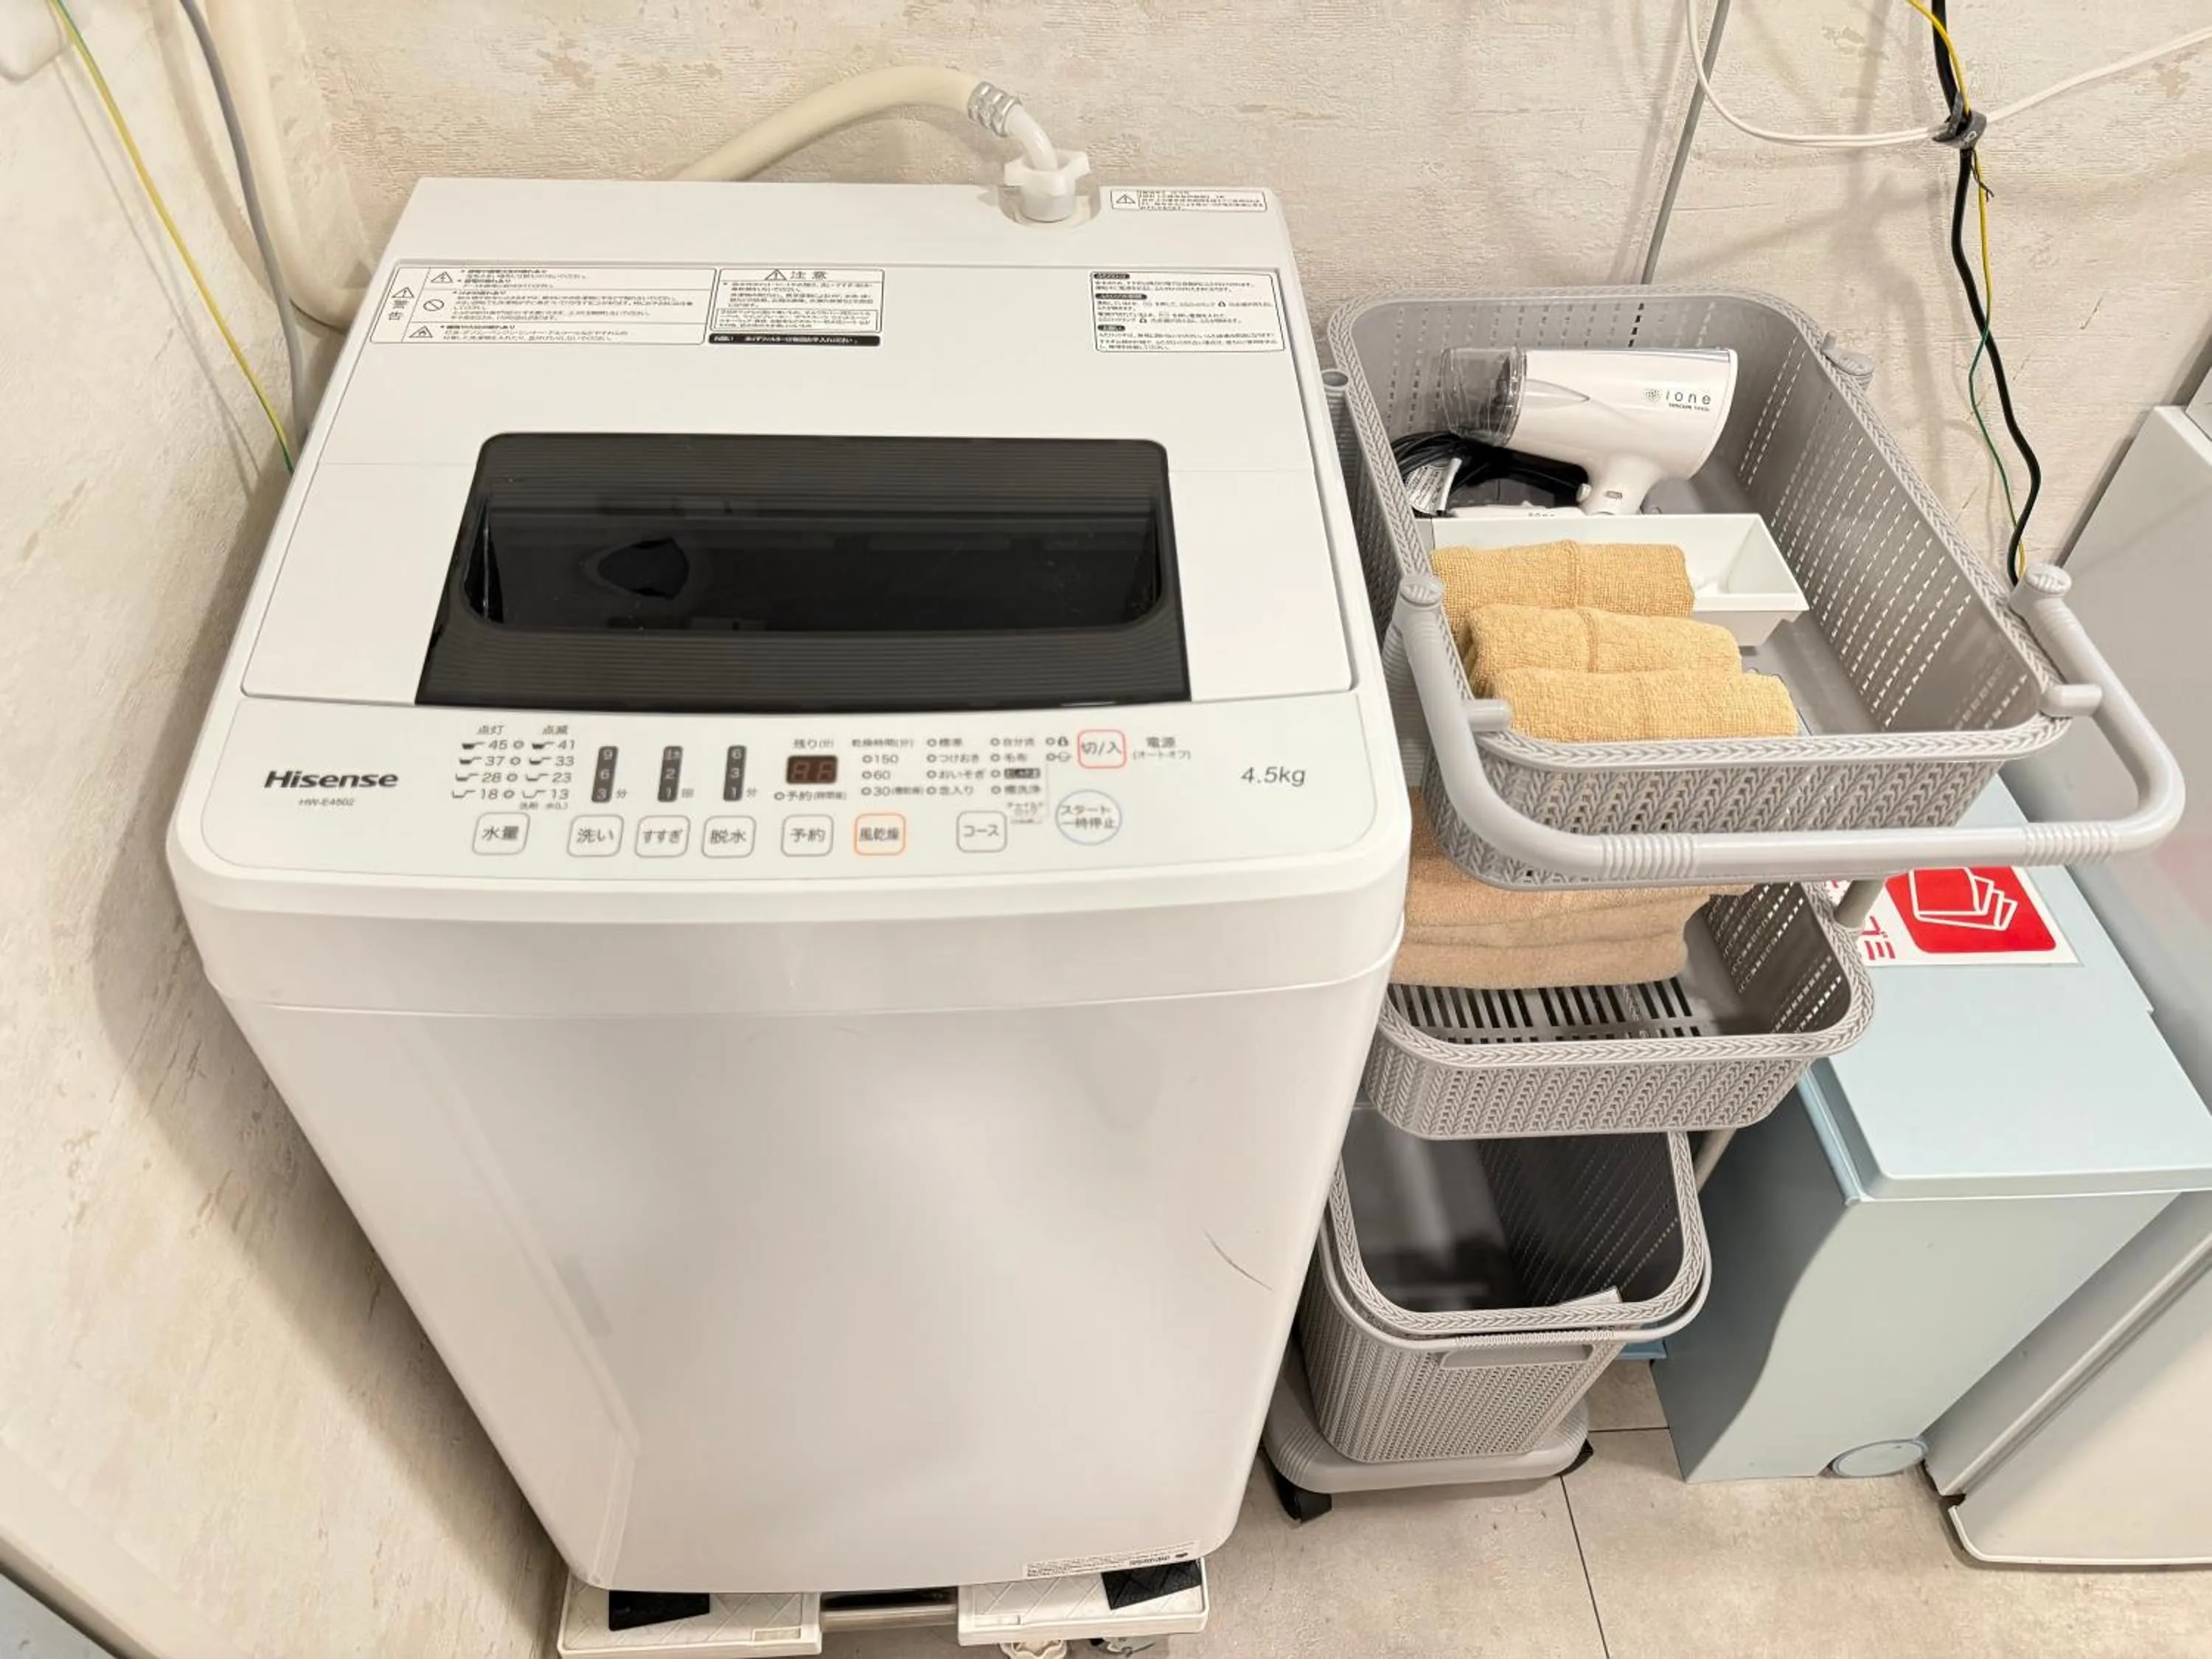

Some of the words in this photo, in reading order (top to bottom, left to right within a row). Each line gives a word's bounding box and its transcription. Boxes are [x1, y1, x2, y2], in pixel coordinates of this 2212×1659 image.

[488, 740, 508, 750] 45
[557, 740, 575, 750] 41
[731, 750, 741, 759] 6
[485, 756, 505, 767] 37
[555, 756, 574, 767] 33
[264, 770, 399, 788] Hisense
[481, 773, 501, 784] 28
[552, 773, 571, 784] 23
[666, 768, 676, 779] 2
[731, 768, 740, 779] 3
[1241, 766, 1306, 787] 4.5kg
[481, 789, 498, 799] 18
[552, 789, 569, 799] 13
[1060, 804, 1111, 815] スタート
[1060, 817, 1116, 830] 一時停止
[482, 825, 519, 841] 水量
[577, 828, 614, 844] 洗い
[643, 830, 684, 844] すすぎ
[710, 830, 746, 844] 脱水
[790, 828, 826, 843] 予約
[964, 824, 998, 837] コース
